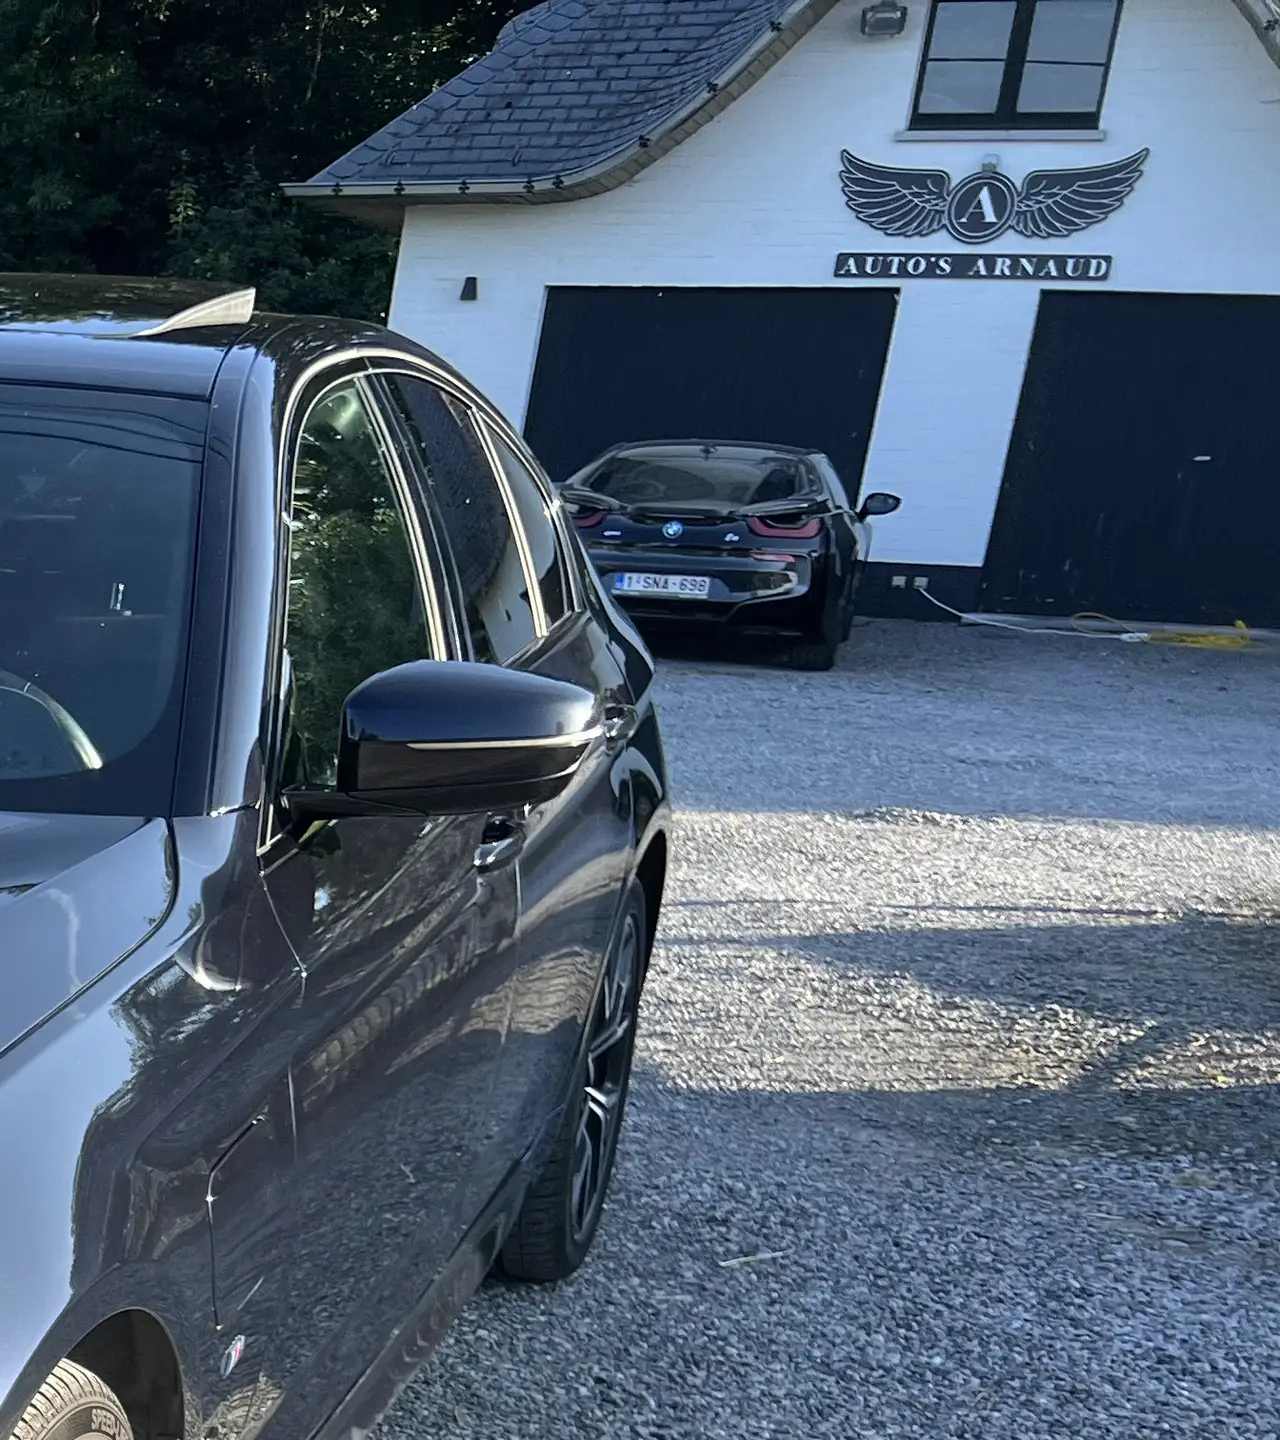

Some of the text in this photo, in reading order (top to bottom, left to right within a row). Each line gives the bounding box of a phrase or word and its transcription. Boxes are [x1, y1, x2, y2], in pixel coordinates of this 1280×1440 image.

[958, 186, 998, 223] A
[836, 255, 1107, 278] AUTO'S ARNAUD
